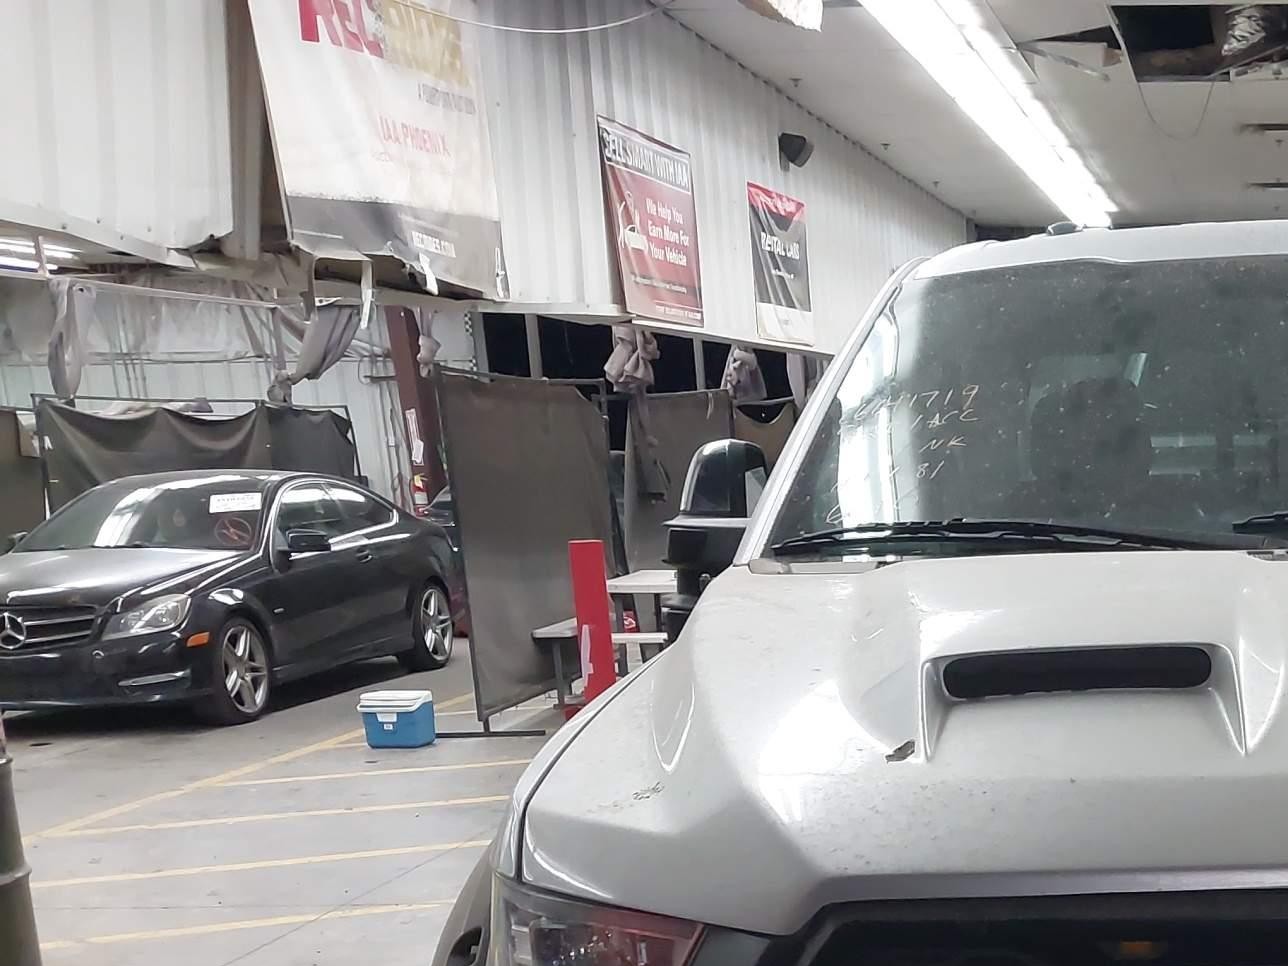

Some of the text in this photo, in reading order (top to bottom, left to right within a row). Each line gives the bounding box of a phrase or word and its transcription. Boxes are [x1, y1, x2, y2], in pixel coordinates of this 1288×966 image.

[400, 122, 452, 156] PHOENIX
[603, 132, 626, 163] SELL
[626, 142, 655, 175] SMART
[657, 201, 673, 223] Help
[671, 207, 684, 224] You
[648, 219, 690, 247] Earn More For
[649, 240, 687, 268] Your Vehicle
